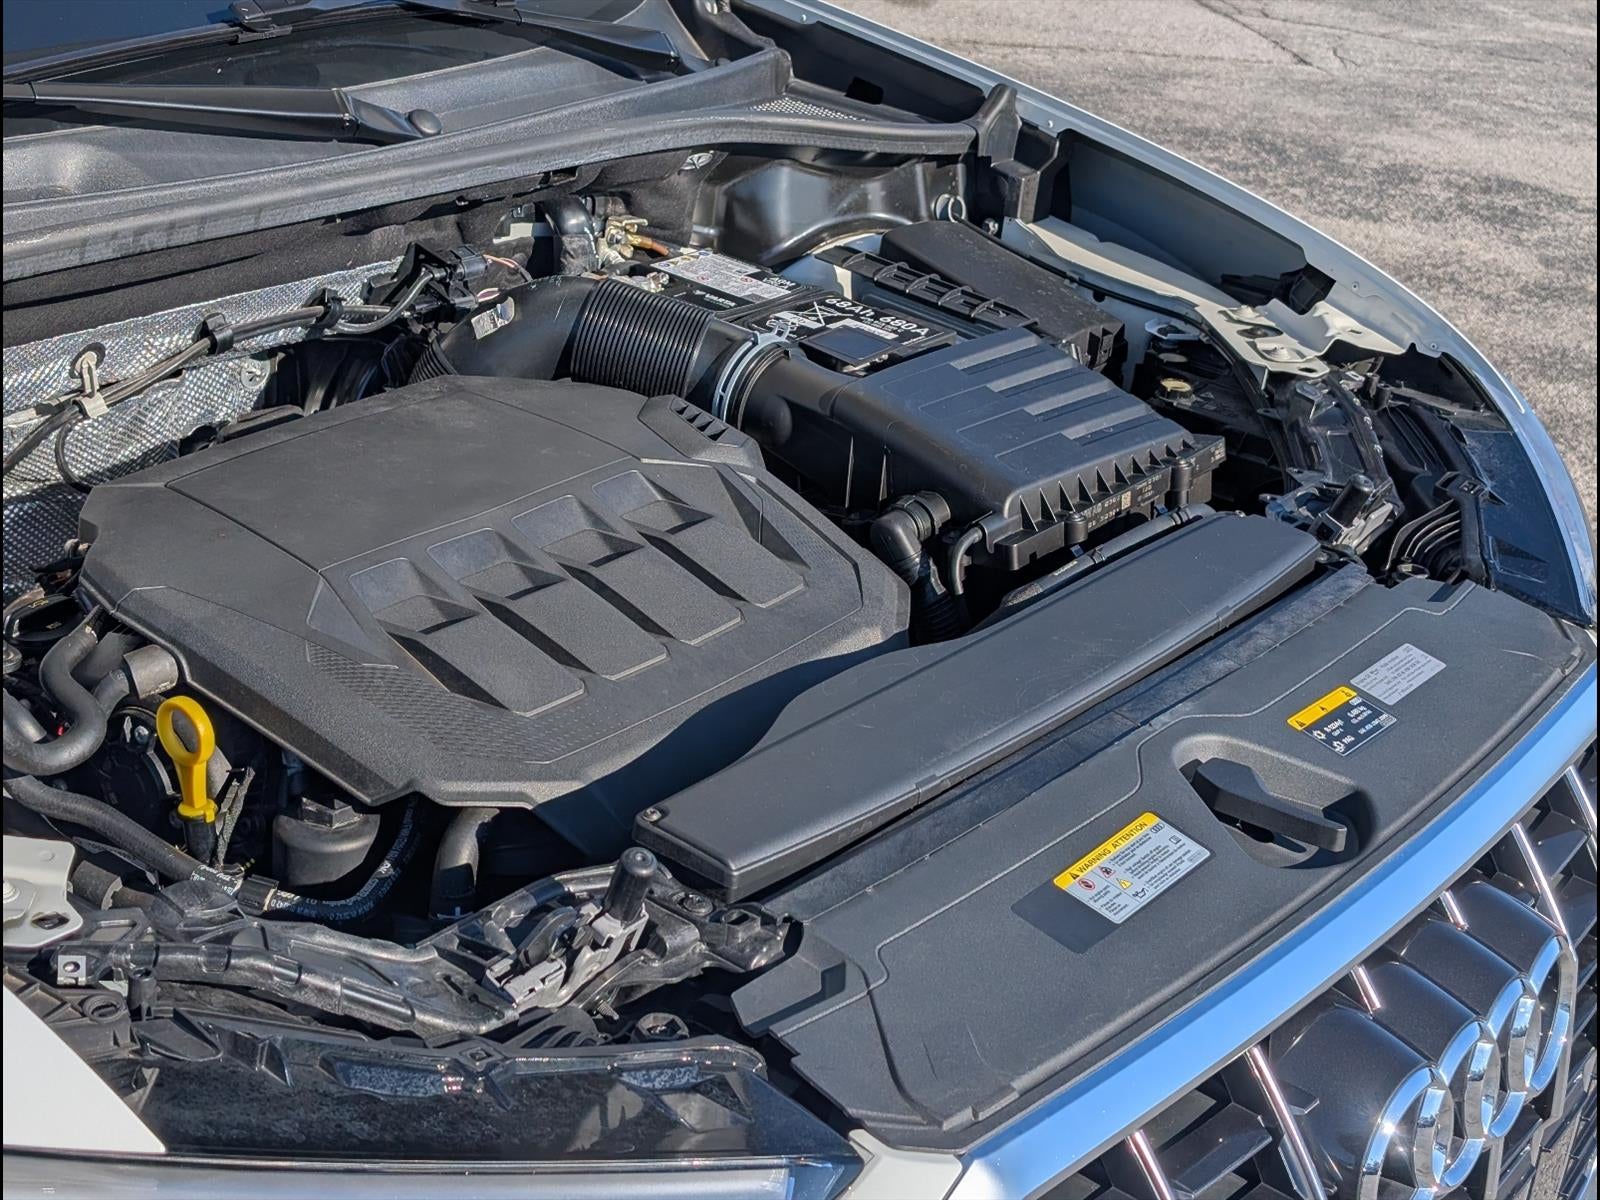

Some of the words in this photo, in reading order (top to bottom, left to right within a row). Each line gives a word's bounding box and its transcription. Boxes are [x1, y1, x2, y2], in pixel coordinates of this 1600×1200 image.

[825, 297, 875, 317] 68Ah
[879, 316, 930, 336] 680A
[1076, 848, 1112, 873] WARNING
[1112, 821, 1148, 849] ATTENTION
